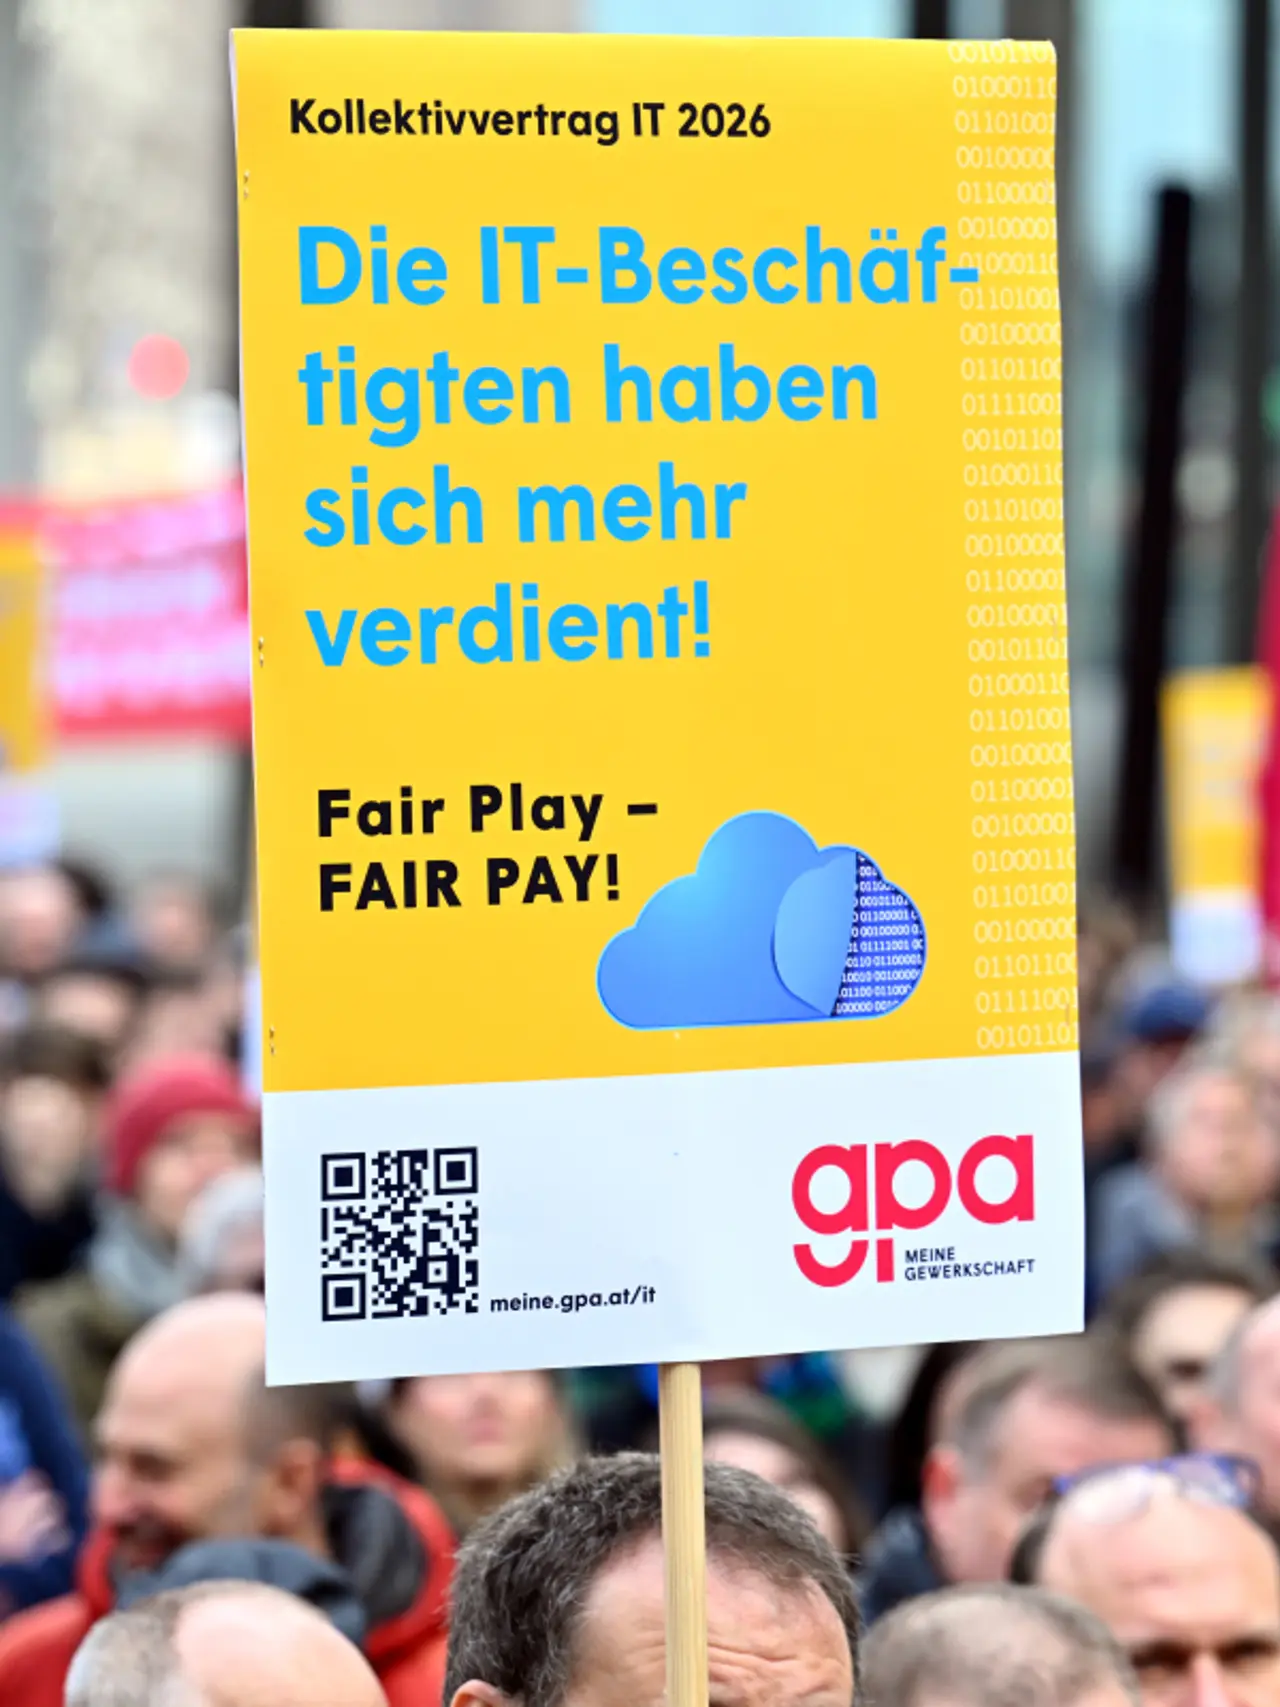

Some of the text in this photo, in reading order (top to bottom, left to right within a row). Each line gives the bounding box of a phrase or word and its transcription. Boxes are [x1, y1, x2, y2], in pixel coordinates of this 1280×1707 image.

[291, 99, 771, 146] Kollektivvertrag IT 2026
[298, 225, 980, 305] Die IT-Beschäf-
[298, 343, 878, 448] tigten haben
[303, 462, 748, 547] sich mehr
[305, 581, 711, 667] verdient!
[318, 786, 445, 838] Fair
[469, 782, 603, 842] Play
[319, 853, 619, 912] FAIR PAY!
[791, 1134, 1035, 1288] gpa
[904, 1246, 956, 1264] MEINE
[904, 1258, 1036, 1282] GEWERKSCHAFT
[490, 1285, 657, 1314] meine.gpa.at/it
